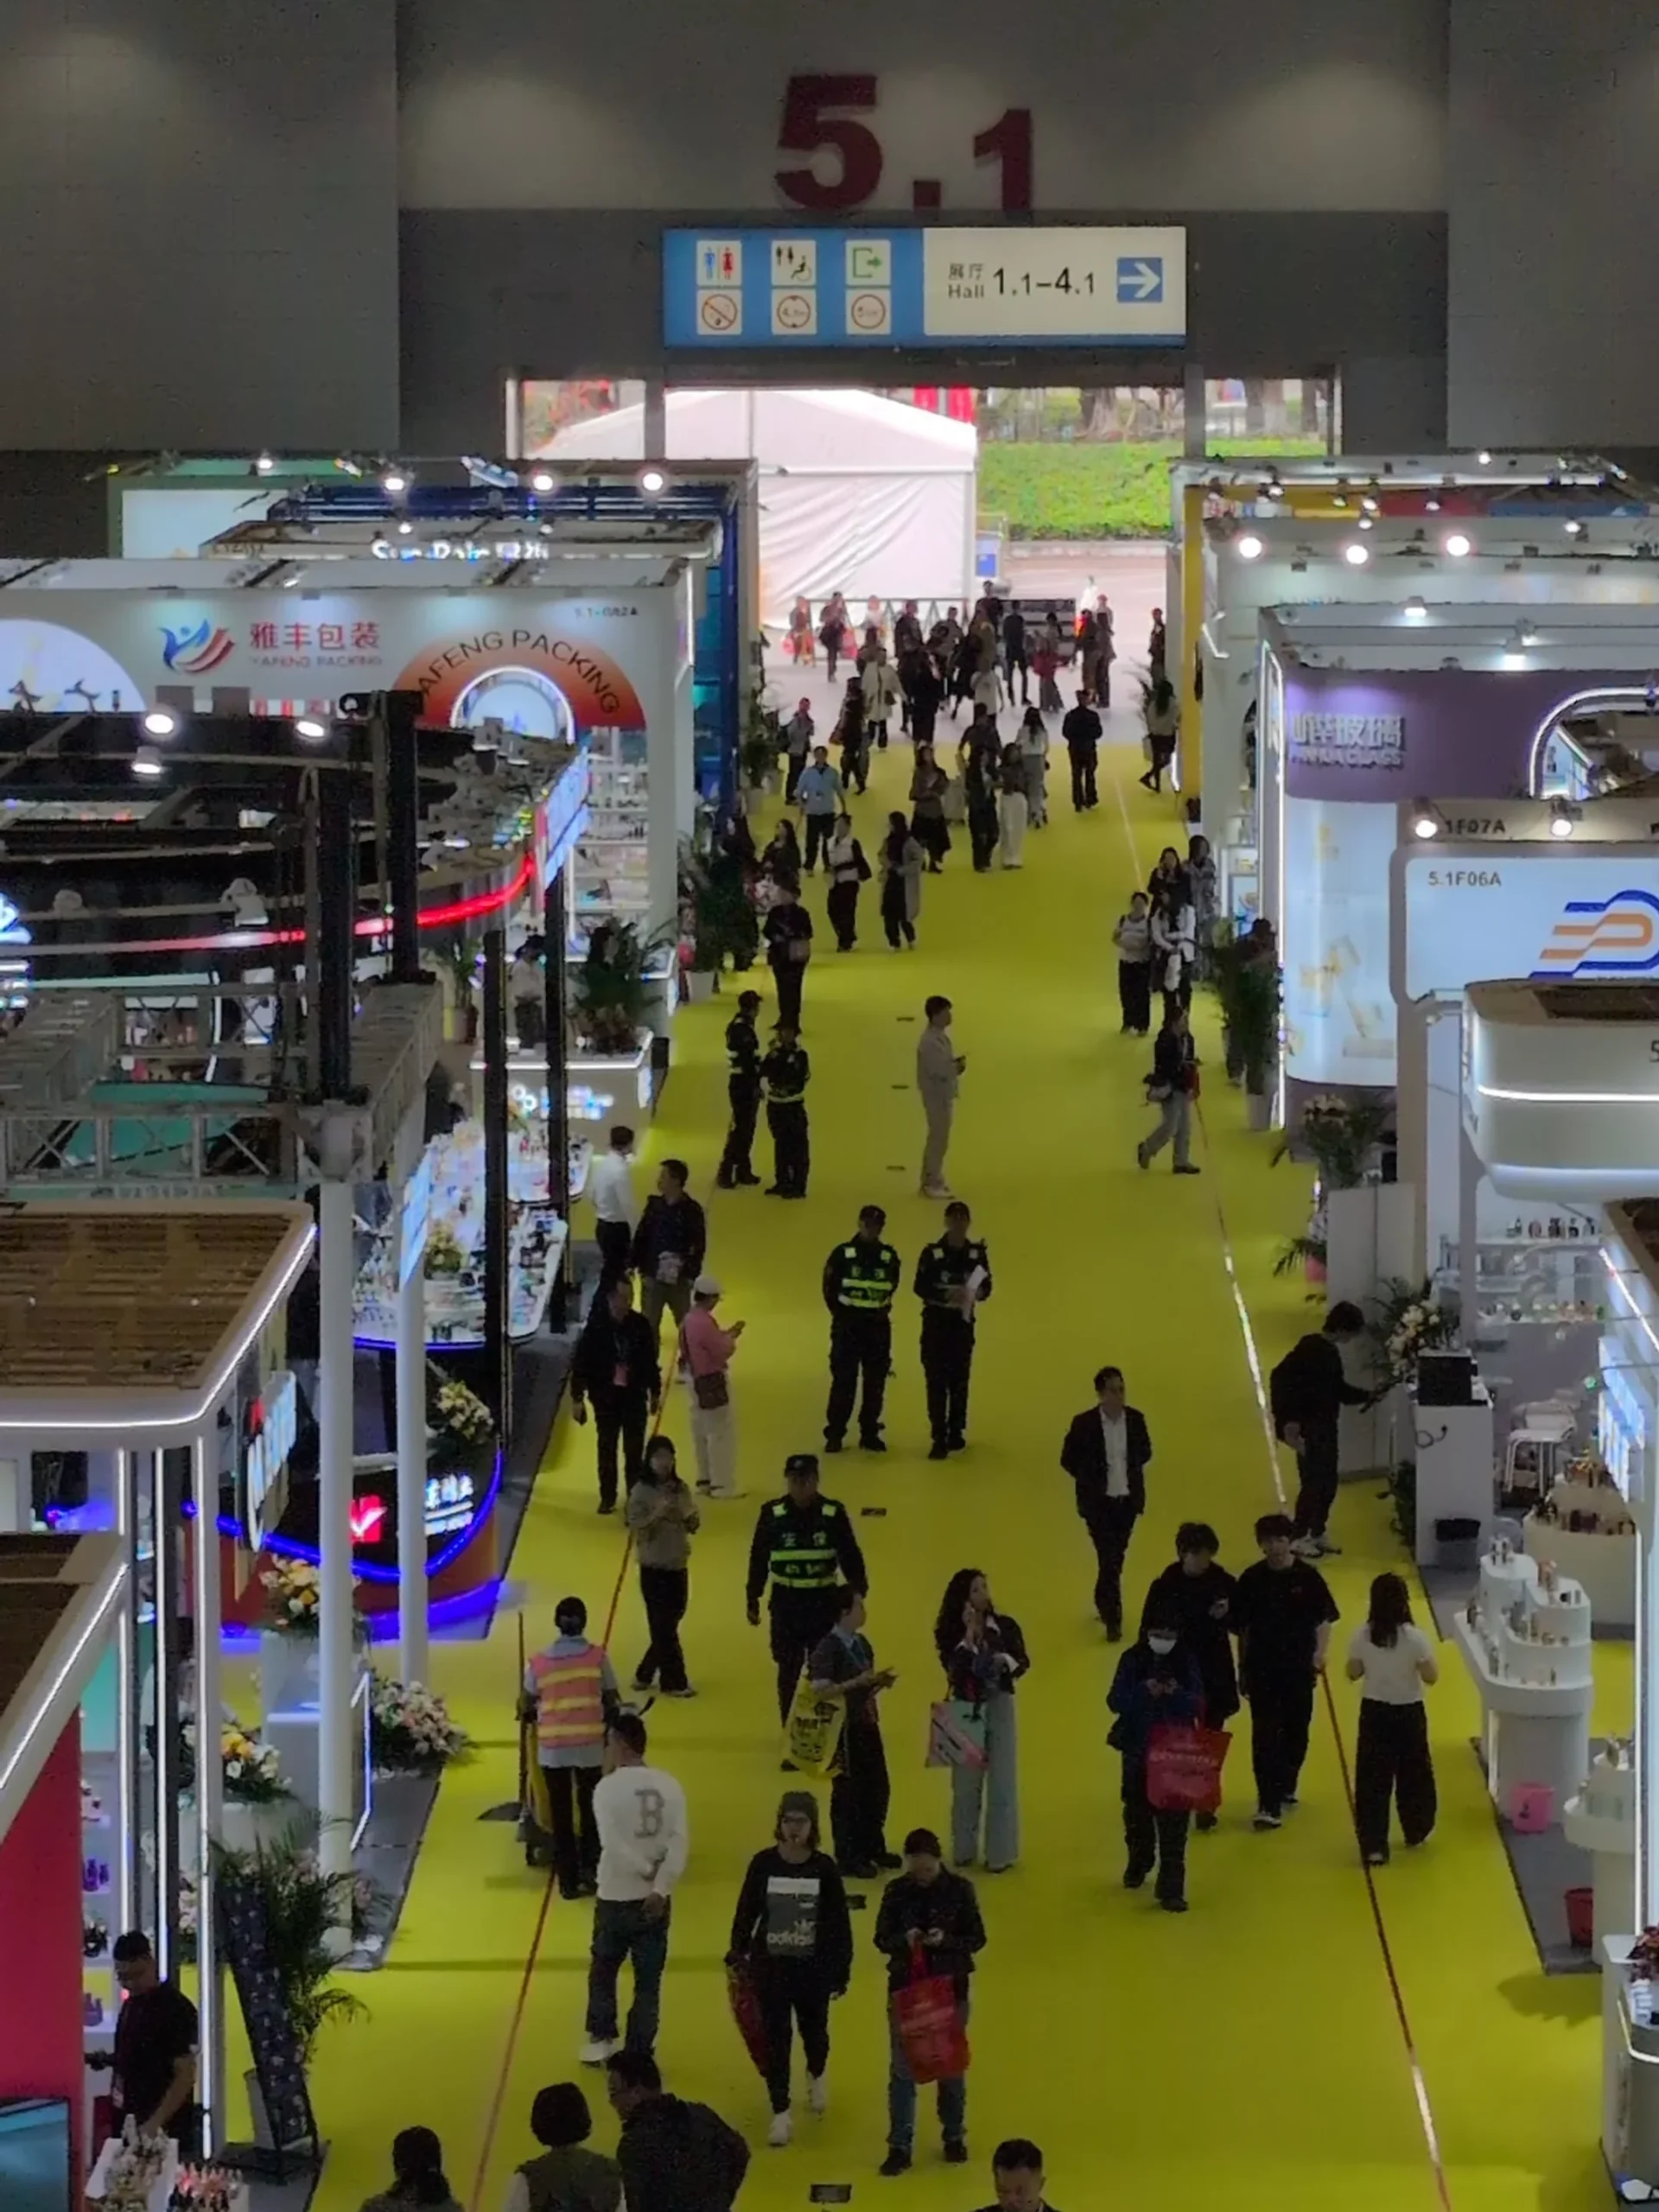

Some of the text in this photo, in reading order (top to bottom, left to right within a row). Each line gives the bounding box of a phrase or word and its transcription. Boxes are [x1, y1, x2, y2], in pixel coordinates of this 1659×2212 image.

[774, 73, 1033, 216] 5.1
[949, 263, 984, 280] 展厅
[948, 284, 984, 299] Hall
[250, 621, 380, 650] 雅丰包装
[316, 656, 382, 667] PACKING
[418, 628, 620, 715] AFENG PACKING
[1445, 818, 1506, 835] 1F07A
[1427, 870, 1502, 887] 5.1F06A
[633, 1788, 665, 1840] B
